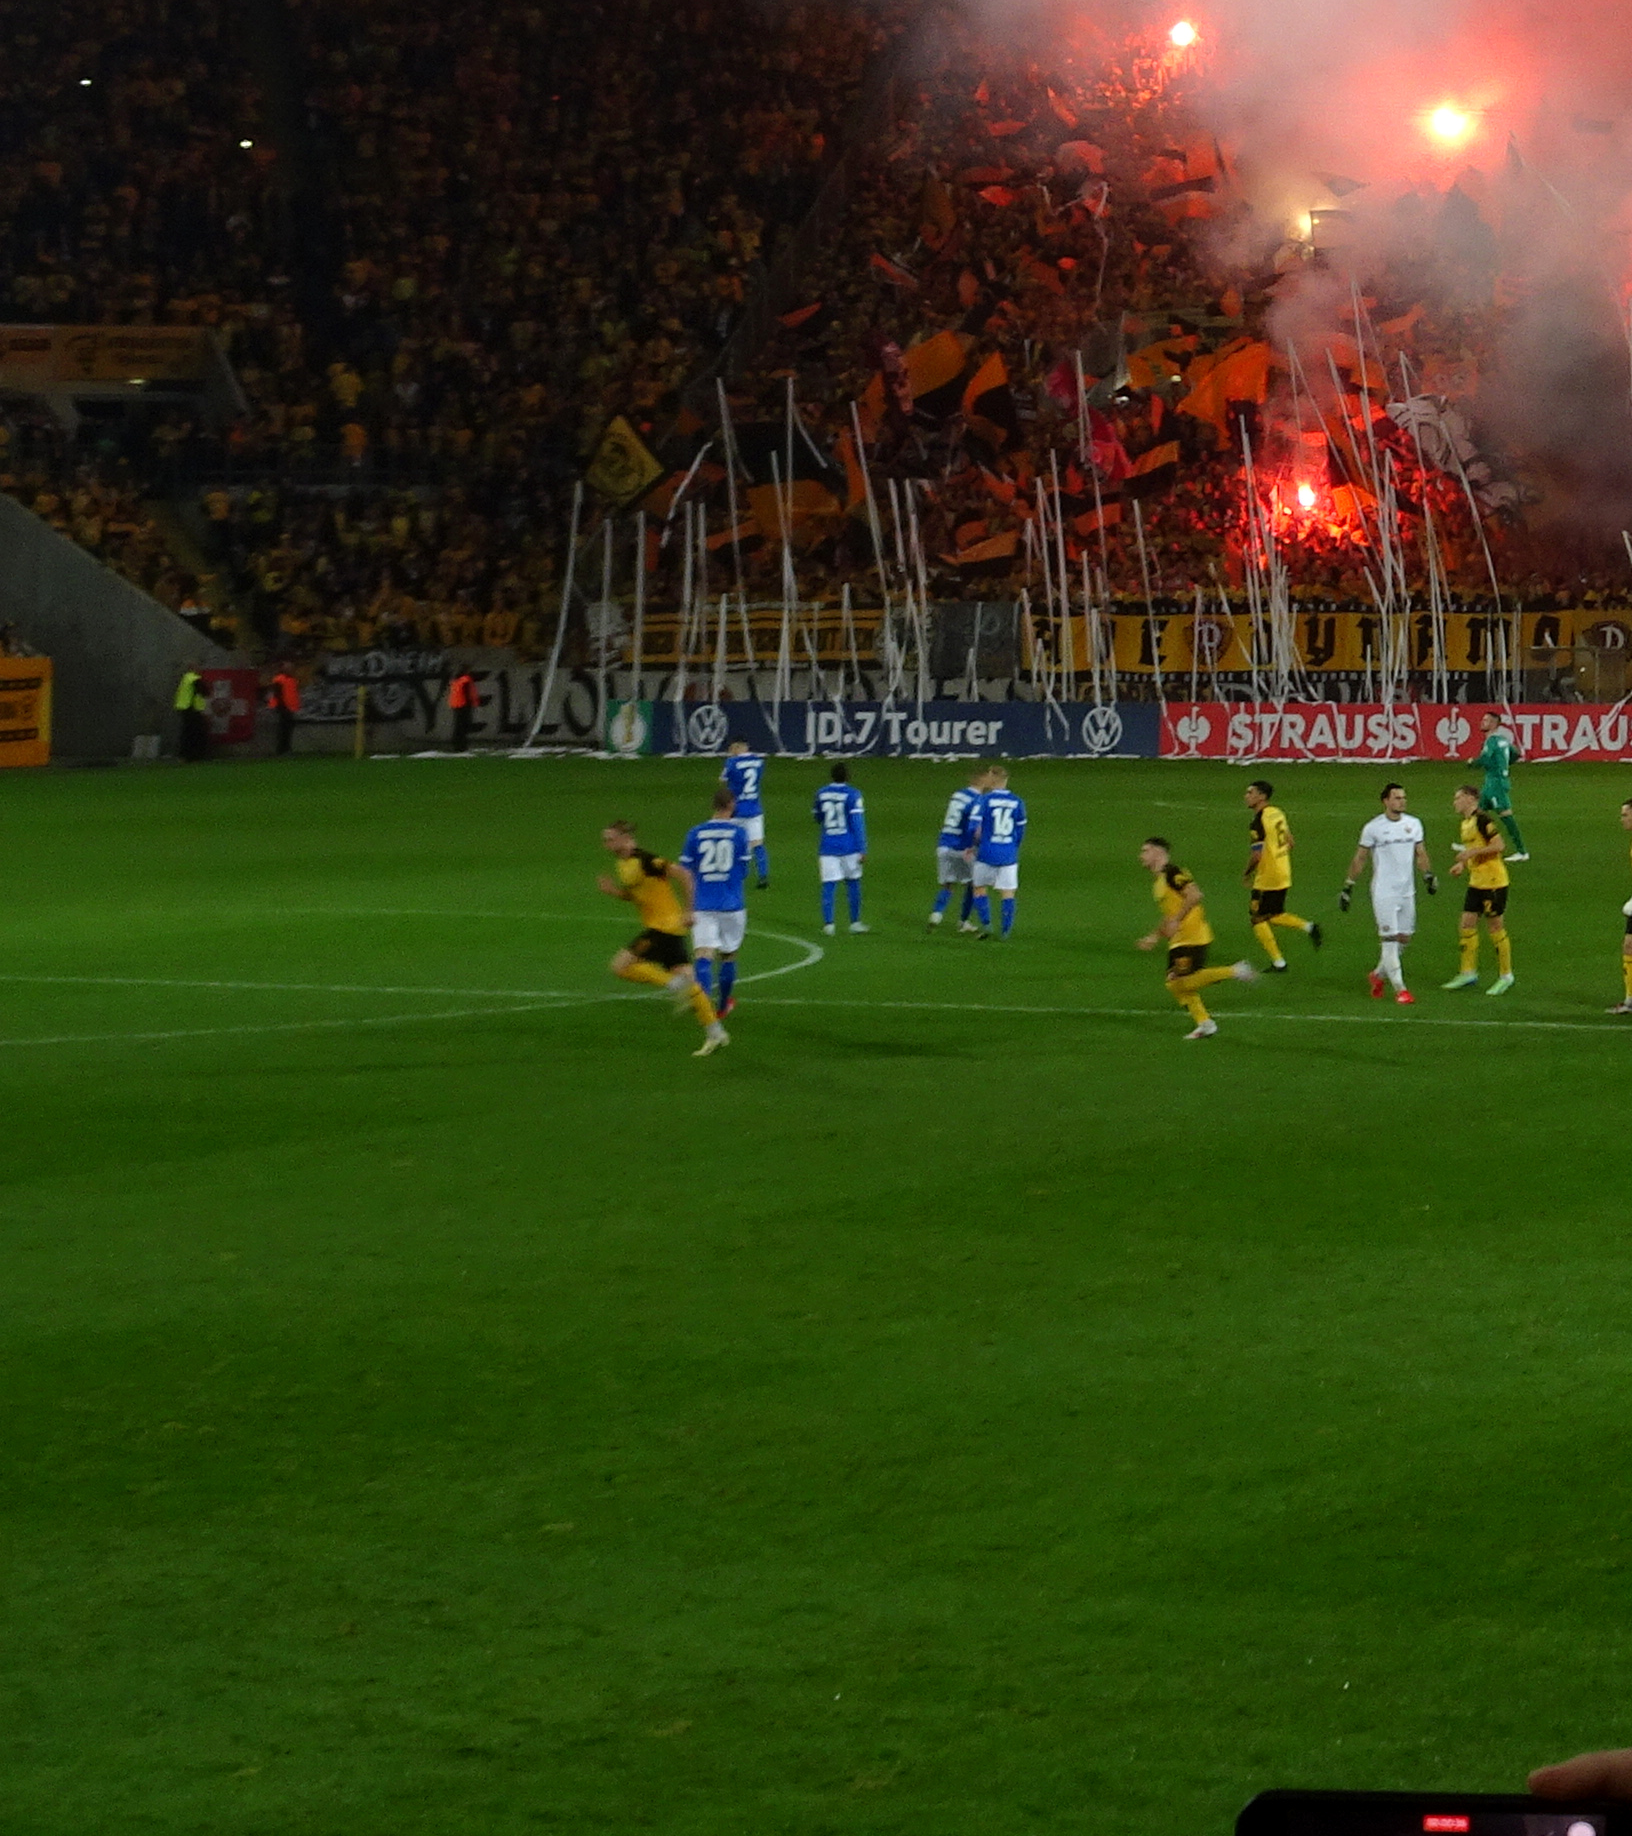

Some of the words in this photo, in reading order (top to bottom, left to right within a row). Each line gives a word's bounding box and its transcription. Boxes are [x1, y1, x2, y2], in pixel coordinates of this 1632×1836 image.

[806, 712, 875, 744] ID.7
[885, 711, 1003, 746] Tourer
[1229, 713, 1418, 751] STRAUSS
[743, 768, 758, 793] 2
[821, 800, 848, 829] 21
[698, 839, 735, 873] 20
